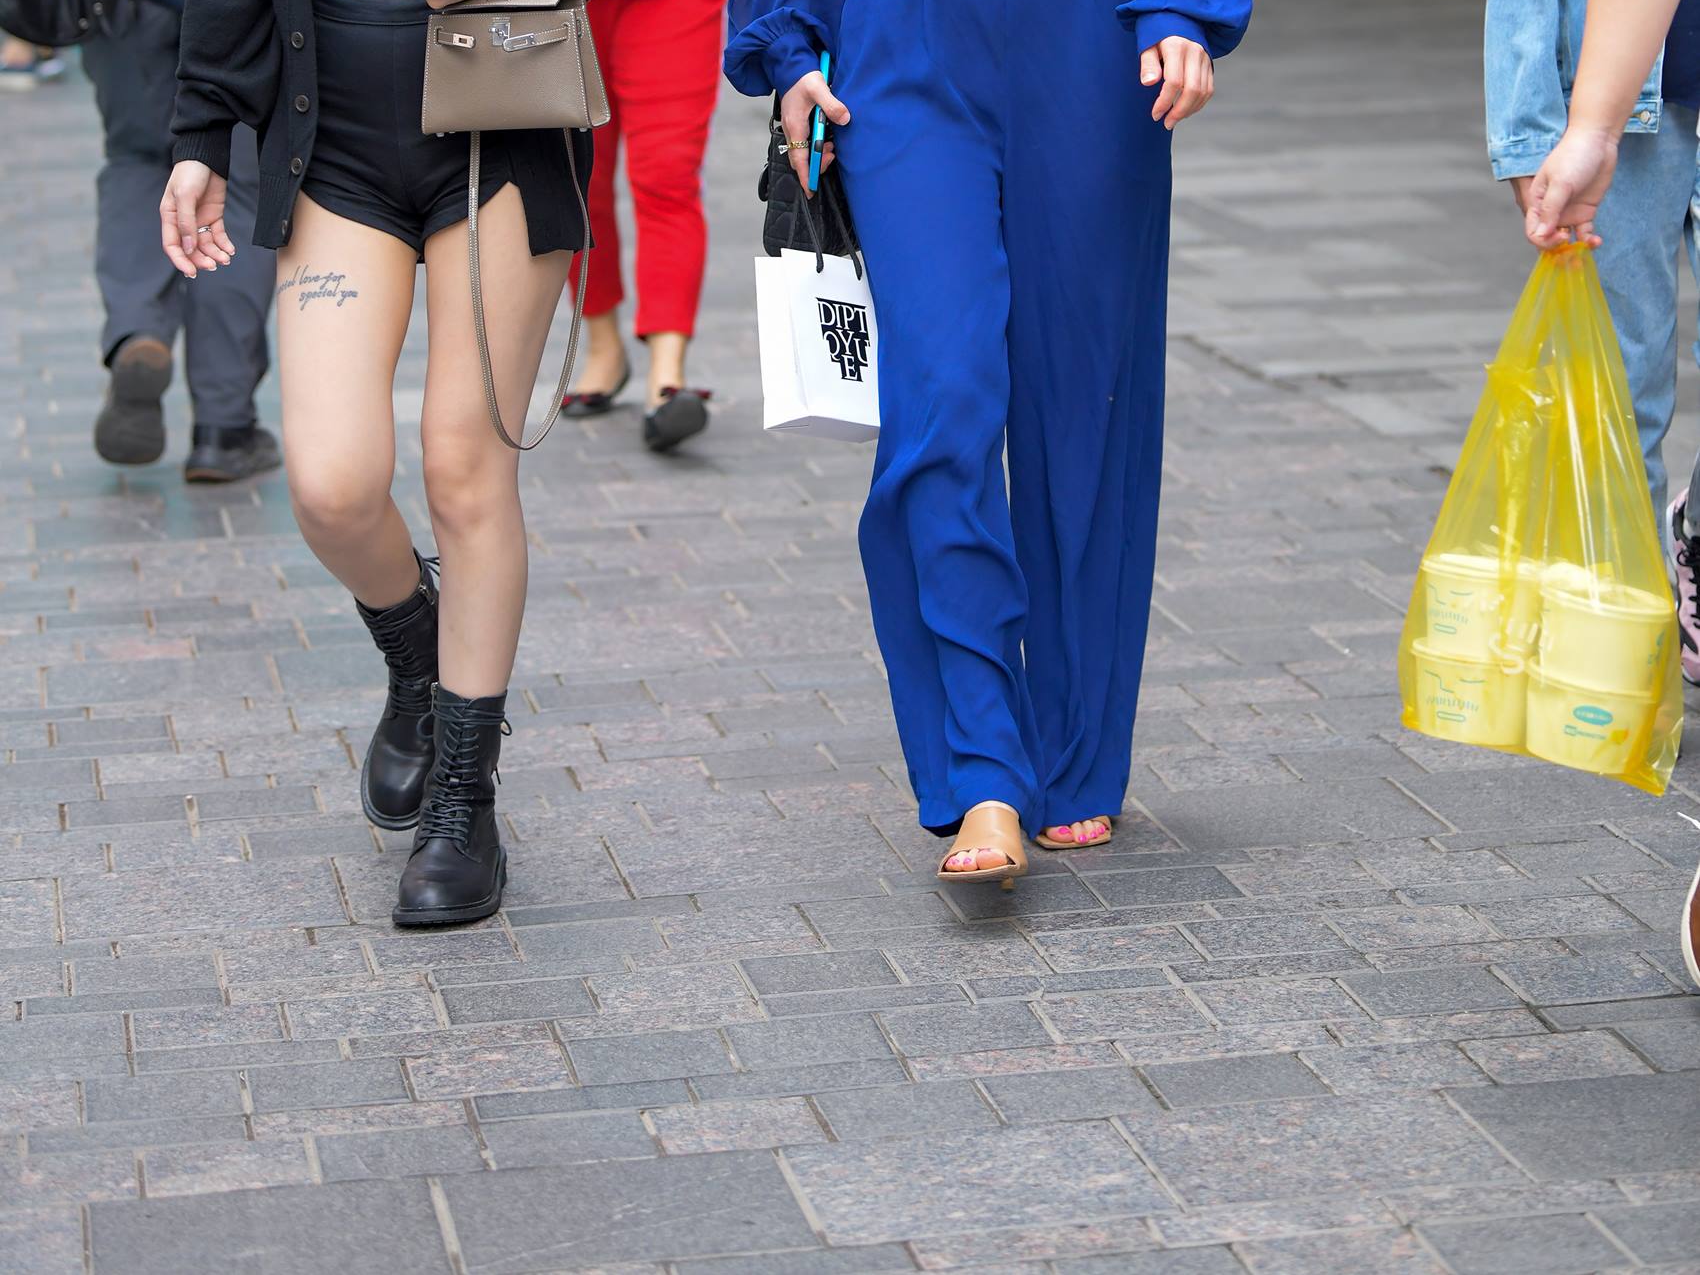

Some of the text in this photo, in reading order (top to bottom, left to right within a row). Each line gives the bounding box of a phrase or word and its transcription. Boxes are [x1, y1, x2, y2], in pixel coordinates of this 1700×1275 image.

[299, 264, 321, 285] love
[299, 280, 358, 311] special you
[818, 300, 868, 333] DIPT
[841, 354, 858, 380] E
